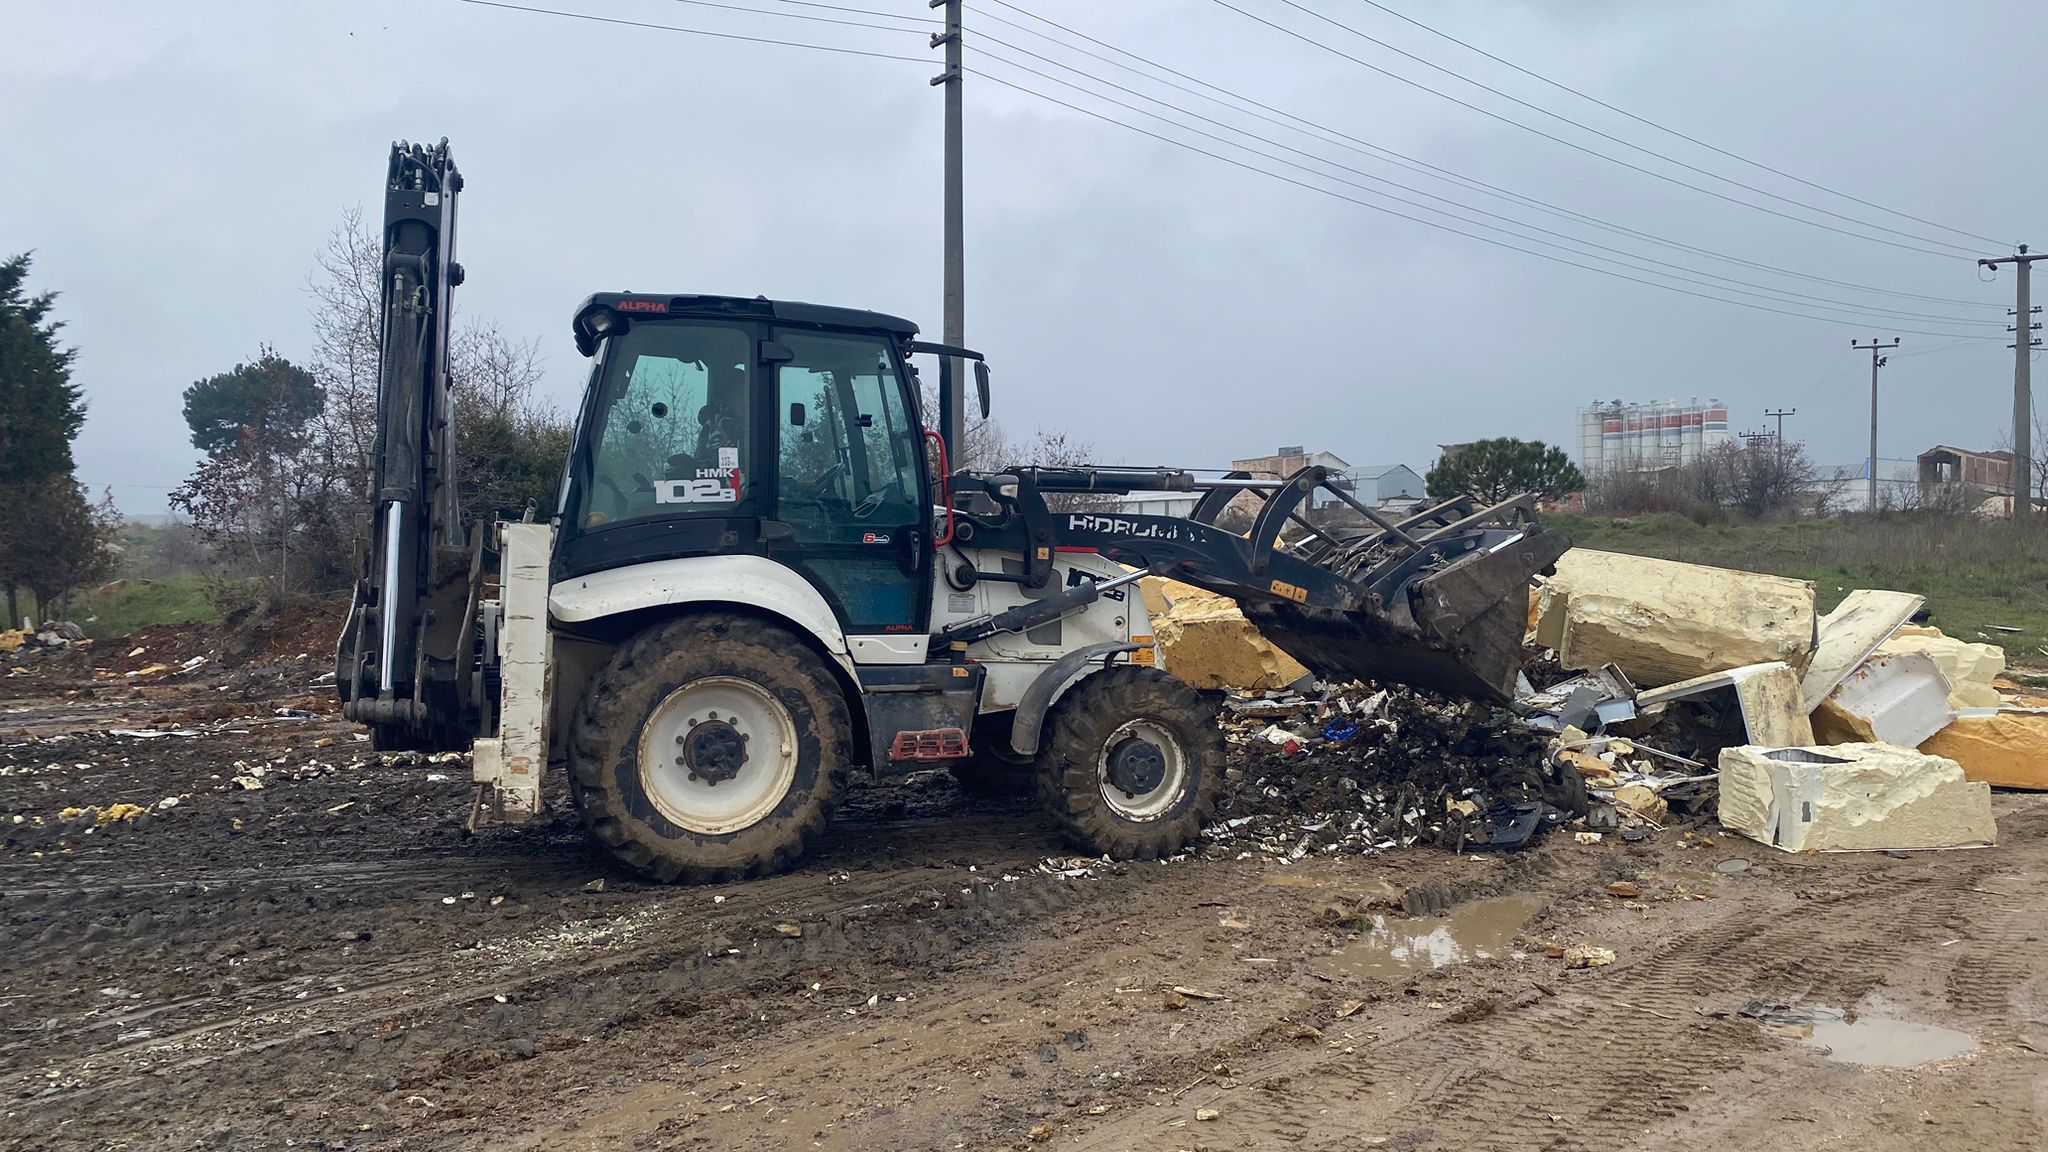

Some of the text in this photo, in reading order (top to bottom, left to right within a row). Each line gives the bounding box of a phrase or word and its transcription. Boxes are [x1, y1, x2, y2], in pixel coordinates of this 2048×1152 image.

[617, 301, 665, 312] ALPHA
[695, 468, 734, 478] HMK
[653, 479, 737, 504] 102B
